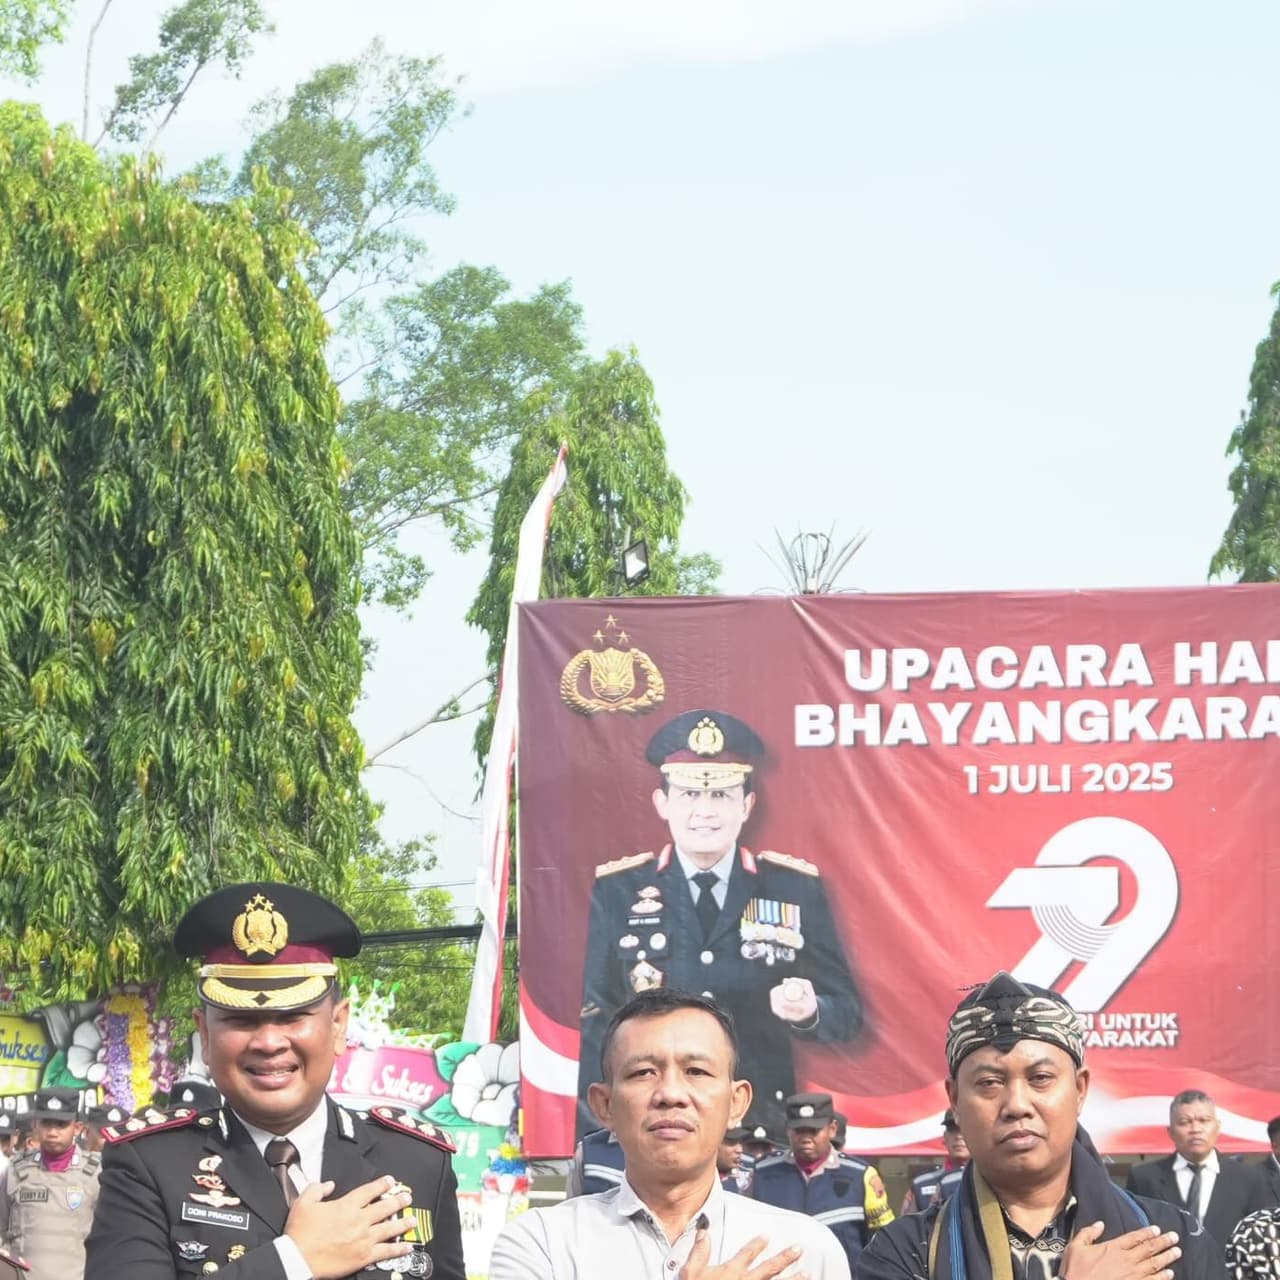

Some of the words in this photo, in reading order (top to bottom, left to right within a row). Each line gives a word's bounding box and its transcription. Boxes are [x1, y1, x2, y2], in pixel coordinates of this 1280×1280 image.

[844, 643, 1153, 692] UPACARA
[963, 765, 979, 794] 1
[987, 764, 1071, 794] JULI
[1081, 761, 1174, 792] 2025
[1100, 1013, 1178, 1029] UNTUK
